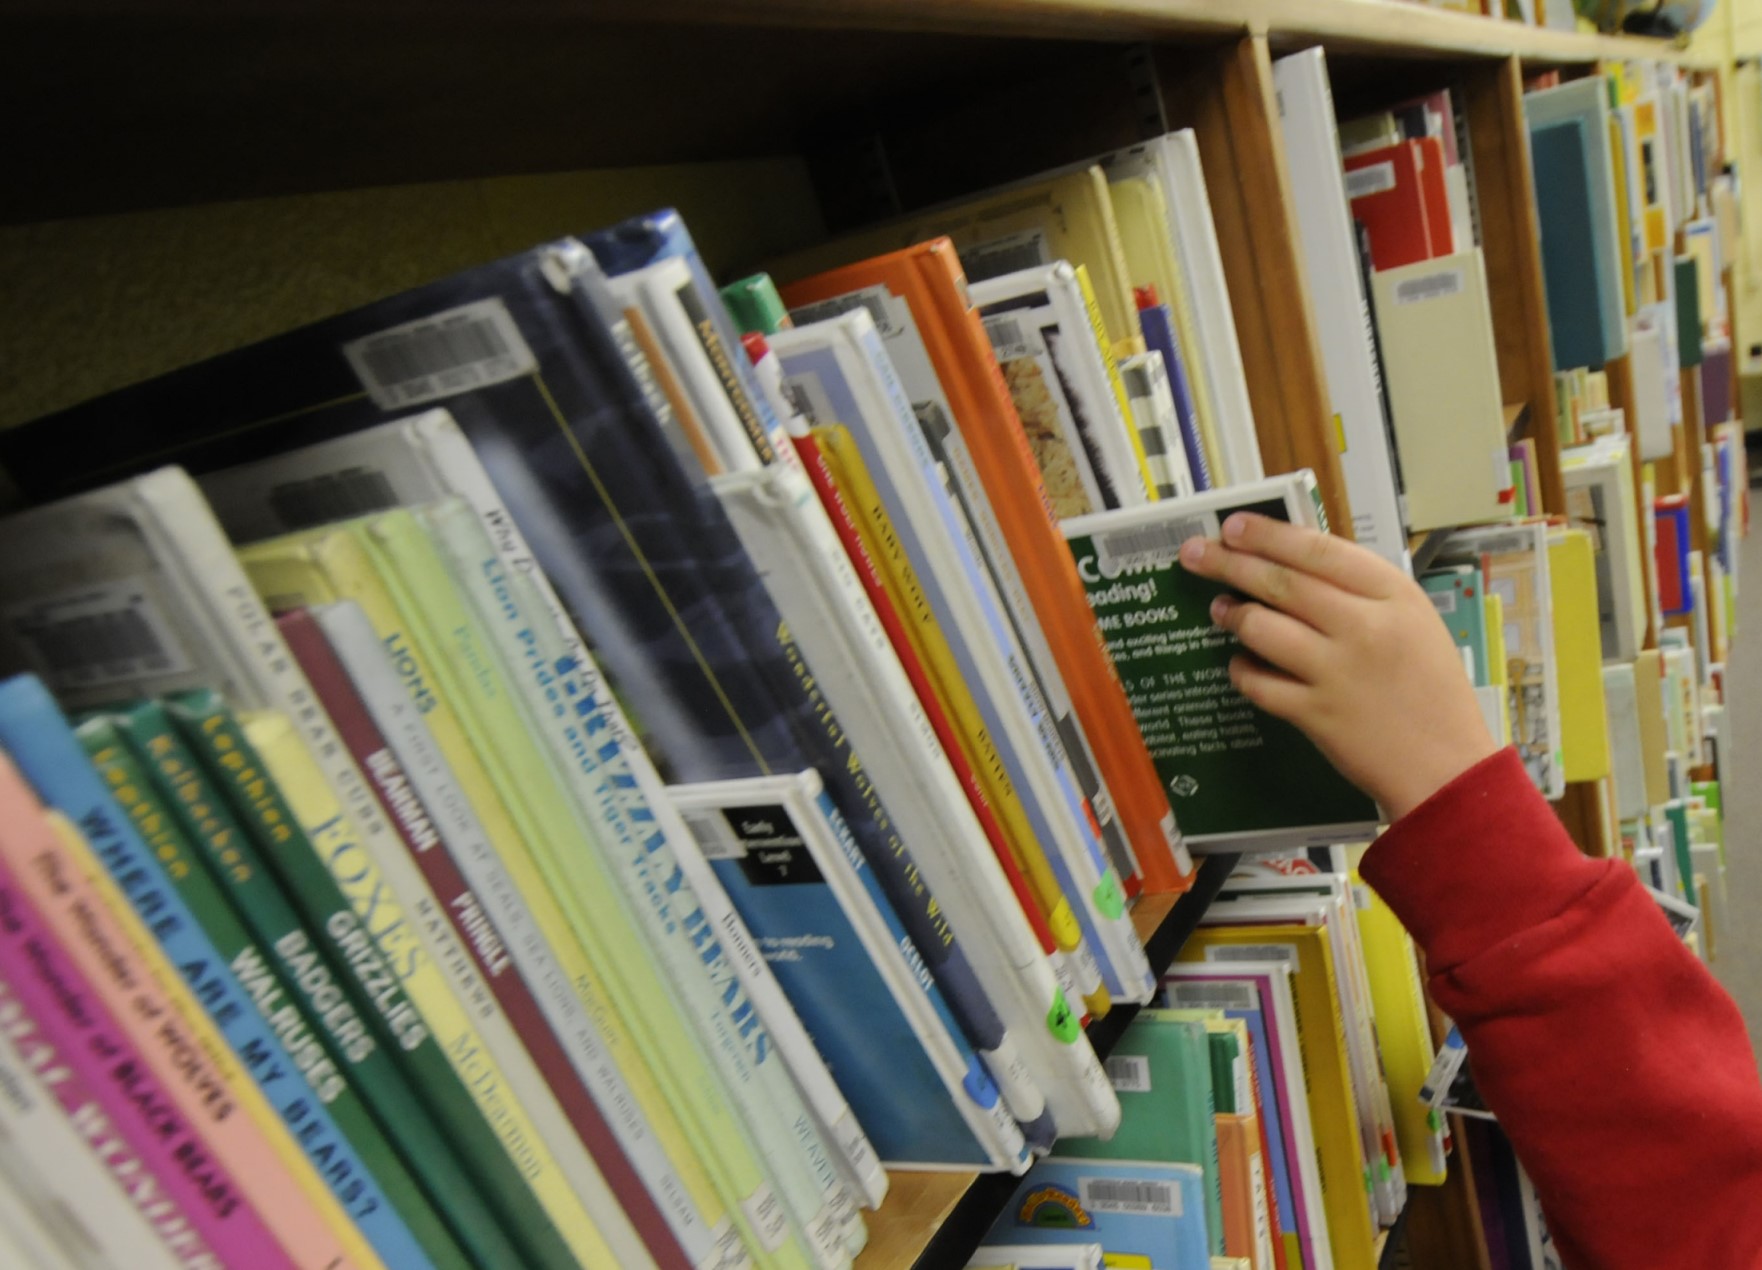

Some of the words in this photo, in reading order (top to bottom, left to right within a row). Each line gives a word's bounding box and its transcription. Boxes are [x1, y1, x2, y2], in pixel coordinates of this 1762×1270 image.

[481, 504, 523, 556] Why
[868, 504, 905, 562] BABY
[896, 564, 936, 627] WOLF
[375, 628, 445, 718] LIONS
[1122, 604, 1179, 628] BOOKS
[1125, 632, 1167, 650] exciting
[1131, 646, 1153, 659] and
[1153, 640, 1188, 658] things
[1188, 639, 1200, 650] in
[1139, 675, 1155, 688] OF
[1162, 671, 1186, 686] THE
[222, 583, 292, 679] POLAR
[283, 686, 342, 762] BEAR
[332, 765, 389, 840] CUBS
[476, 553, 527, 623] Lion
[510, 625, 575, 721] Prides
[560, 721, 602, 777] and
[586, 779, 639, 852] Tiger
[627, 852, 686, 938] Tracks
[1172, 696, 1219, 715] animals
[1177, 712, 1213, 727] These
[87, 742, 196, 885] Lepthien
[142, 727, 262, 887] Kalbacken
[194, 710, 298, 851] Lepthien
[359, 743, 446, 856] BEARMAN
[767, 619, 852, 751] Wonderful
[838, 750, 895, 832] Wolves
[884, 831, 911, 860] of
[898, 859, 930, 897] the
[918, 895, 959, 949] Wild
[303, 808, 438, 985] FOXES
[386, 699, 408, 720] A
[397, 719, 444, 780] FIRST
[431, 780, 475, 837] LOOK
[465, 838, 492, 867] AT
[517, 930, 551, 969] SEA
[570, 1025, 604, 1063] AND
[590, 1063, 650, 1144] WALRUSES
[545, 651, 697, 898] GRIZZLY
[676, 905, 781, 1067] BEARS
[271, 925, 381, 1067] BADGERS
[321, 904, 432, 1055] GRIZZLIES
[409, 895, 498, 1022] MATTHEWS
[445, 887, 518, 980] PRINGLE
[715, 909, 765, 981] Bonners
[17, 931, 101, 1037] Wonder
[108, 1053, 186, 1148] BLACK
[168, 1133, 245, 1225] BEARS
[64, 893, 144, 996] Wonder
[126, 986, 167, 1027] of
[150, 1013, 241, 1128] WOLVES
[75, 800, 189, 947] WHERE
[178, 949, 247, 1031] ARE
[237, 1033, 288, 1090] MY
[278, 1092, 382, 1226] BEARS?
[225, 942, 350, 1107] WALRUSES
[653, 1170, 700, 1230] SELSAM
